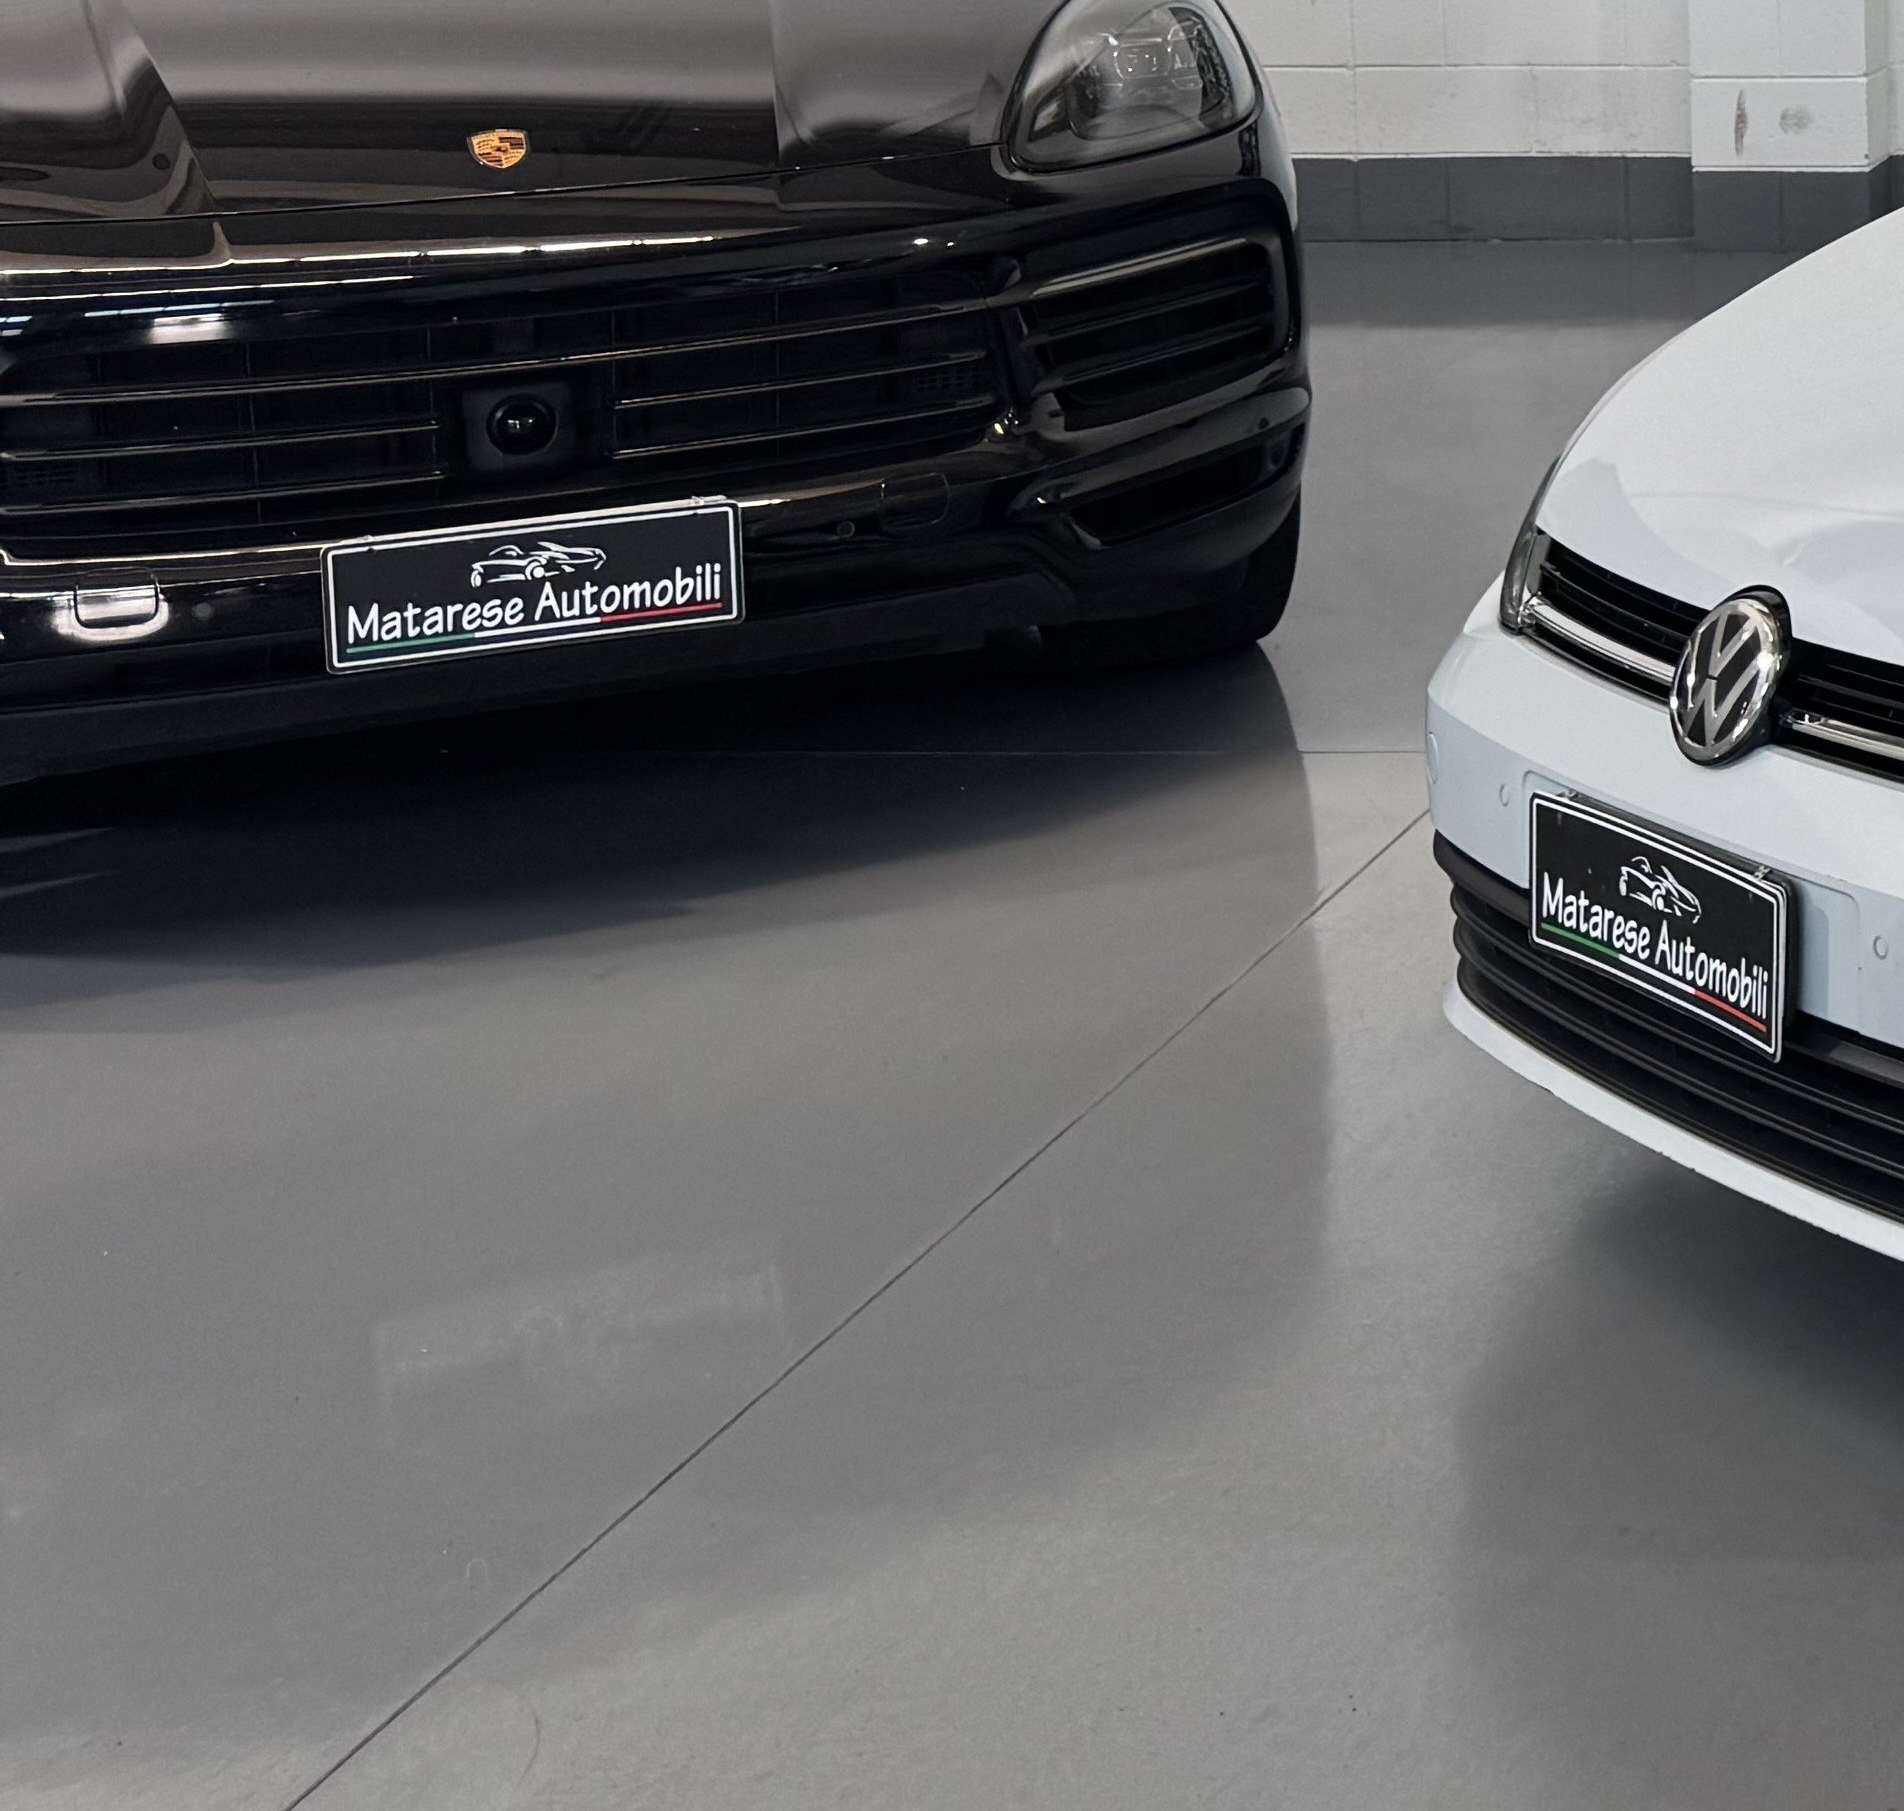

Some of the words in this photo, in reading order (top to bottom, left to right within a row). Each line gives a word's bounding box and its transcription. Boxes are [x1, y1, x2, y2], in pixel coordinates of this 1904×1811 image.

[347, 596, 525, 645] Matarese
[534, 562, 722, 621] Automobili
[1541, 871, 1651, 959] Matarese
[1654, 919, 1769, 1019] Automobili
